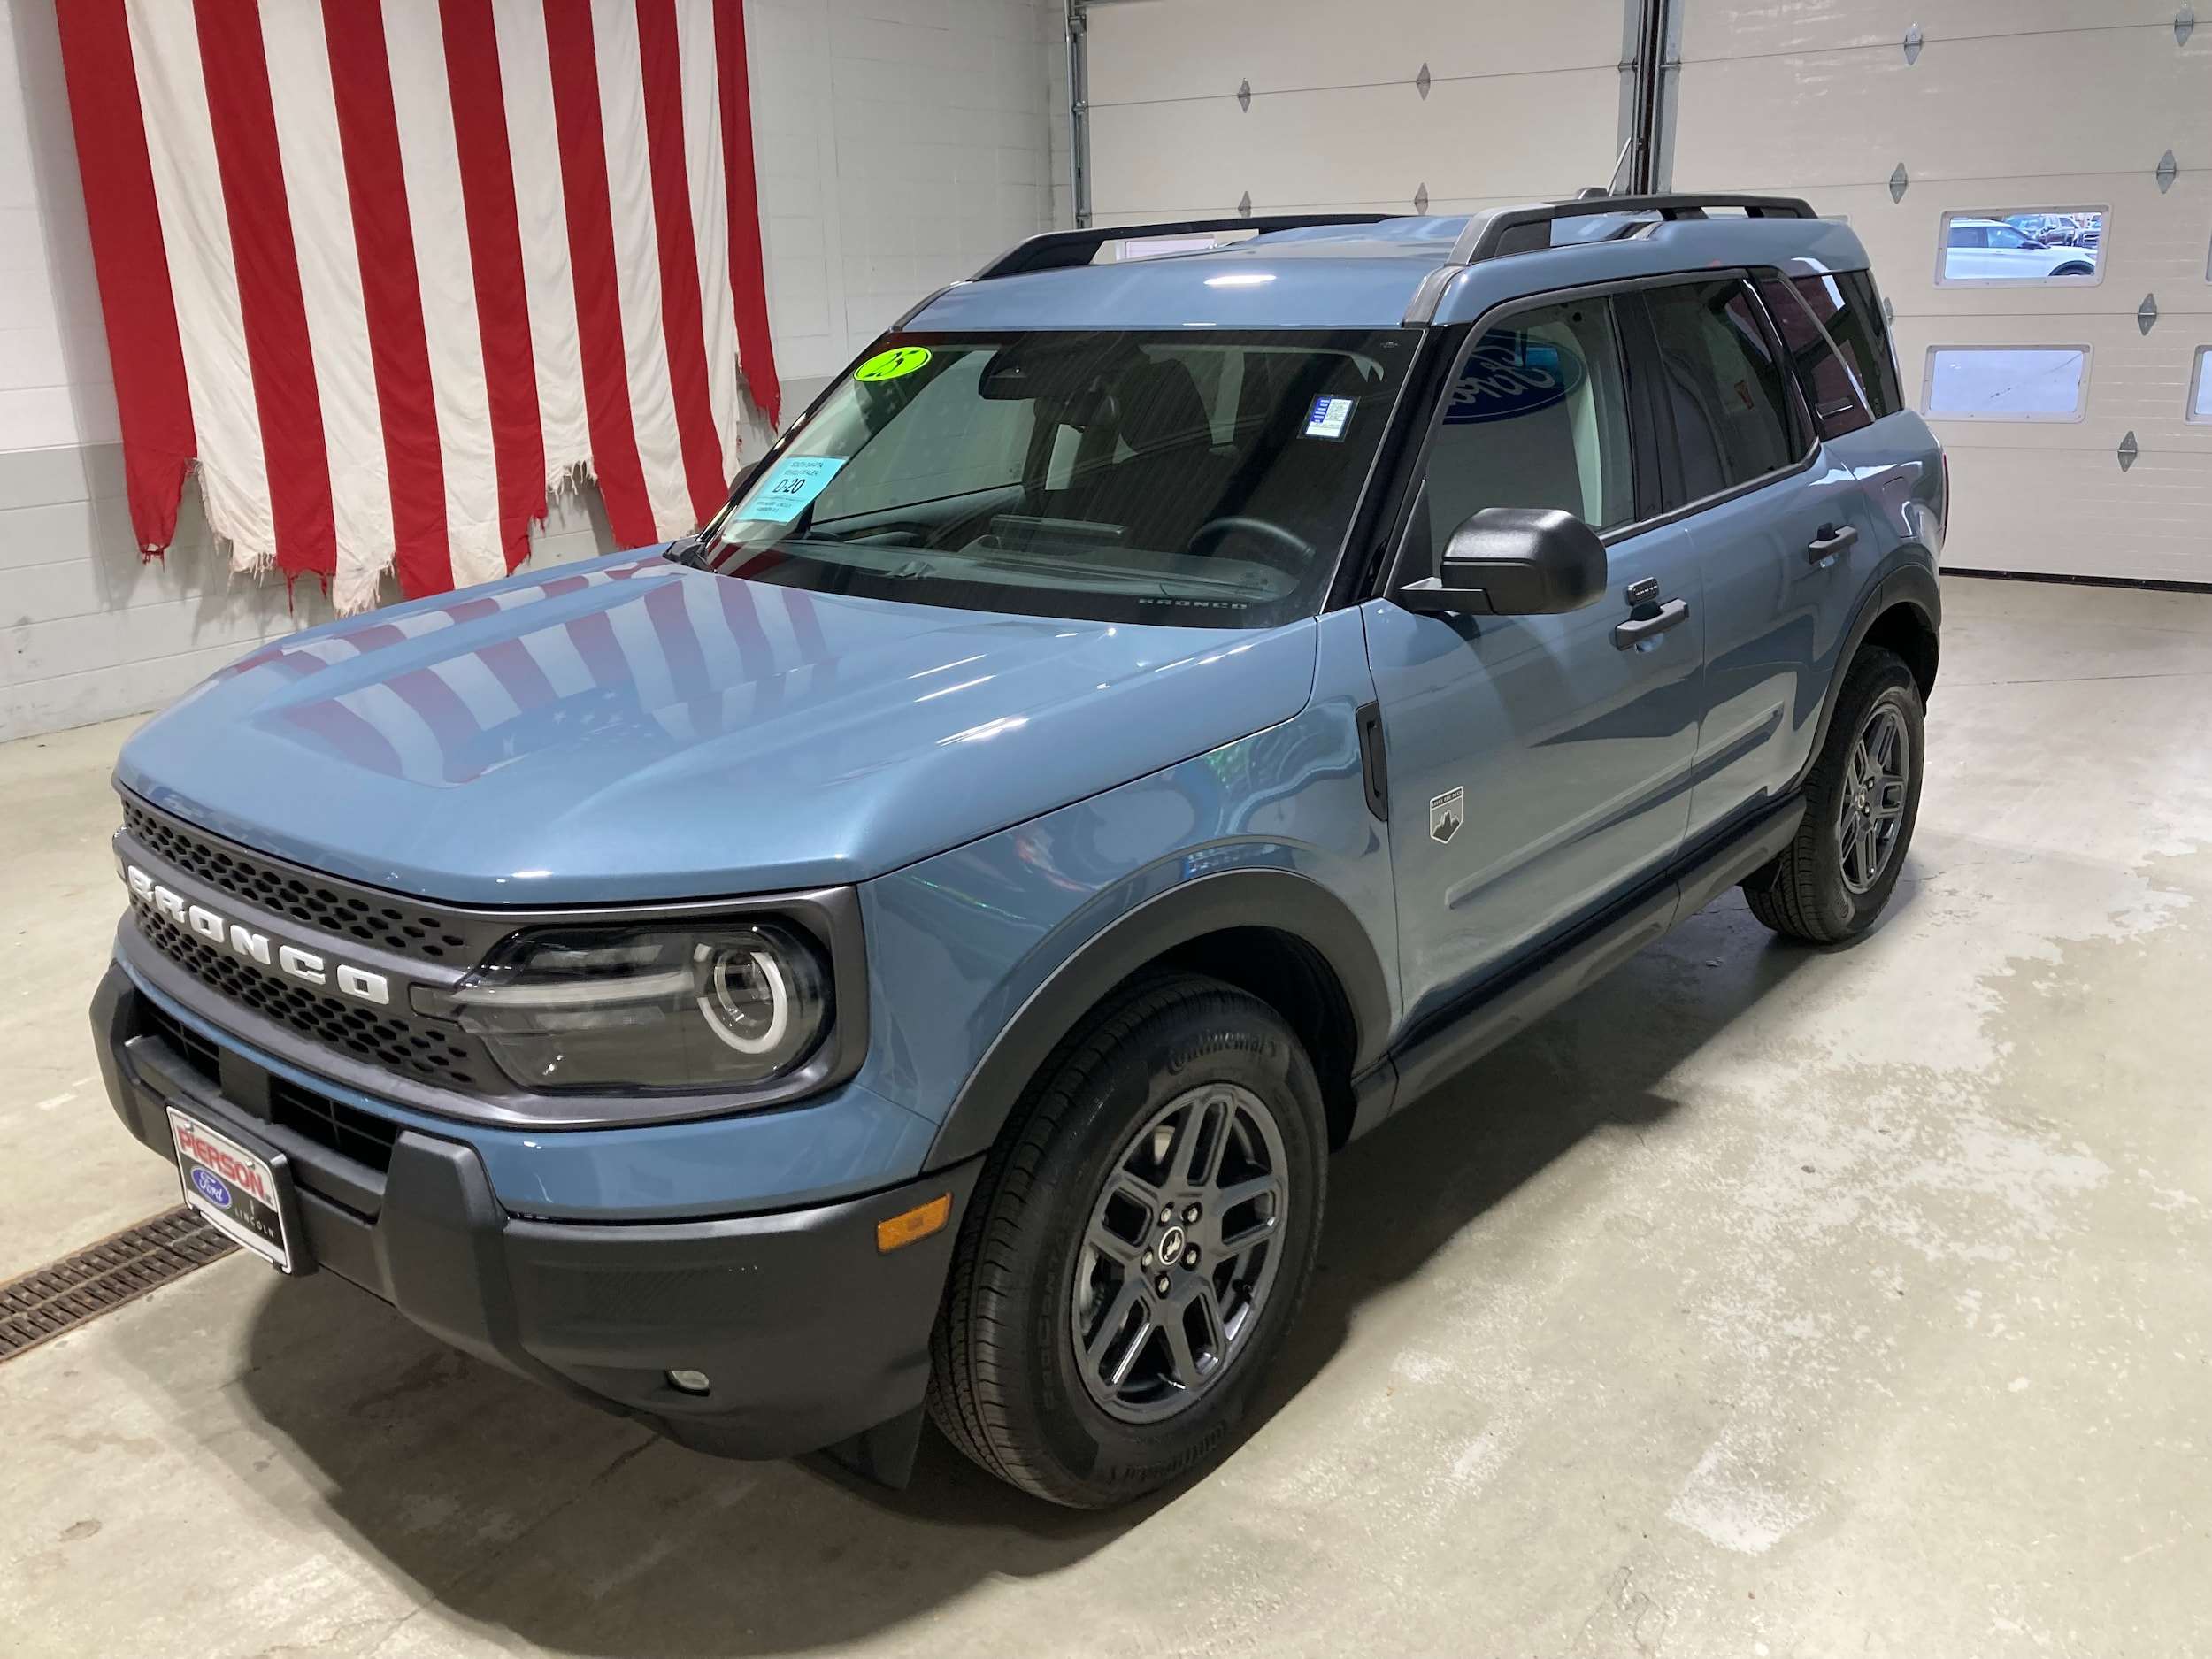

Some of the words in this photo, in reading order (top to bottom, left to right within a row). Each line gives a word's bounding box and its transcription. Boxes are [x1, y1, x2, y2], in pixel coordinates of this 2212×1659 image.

[772, 478, 806, 494] D-20
[1138, 598, 1248, 610] BRONCO
[1444, 790, 1462, 803] BEND
[127, 864, 390, 1005] BRONCO
[1166, 1028, 1264, 1075] Continental
[198, 1170, 225, 1202] Ford
[234, 1207, 275, 1239] LINCOLN
